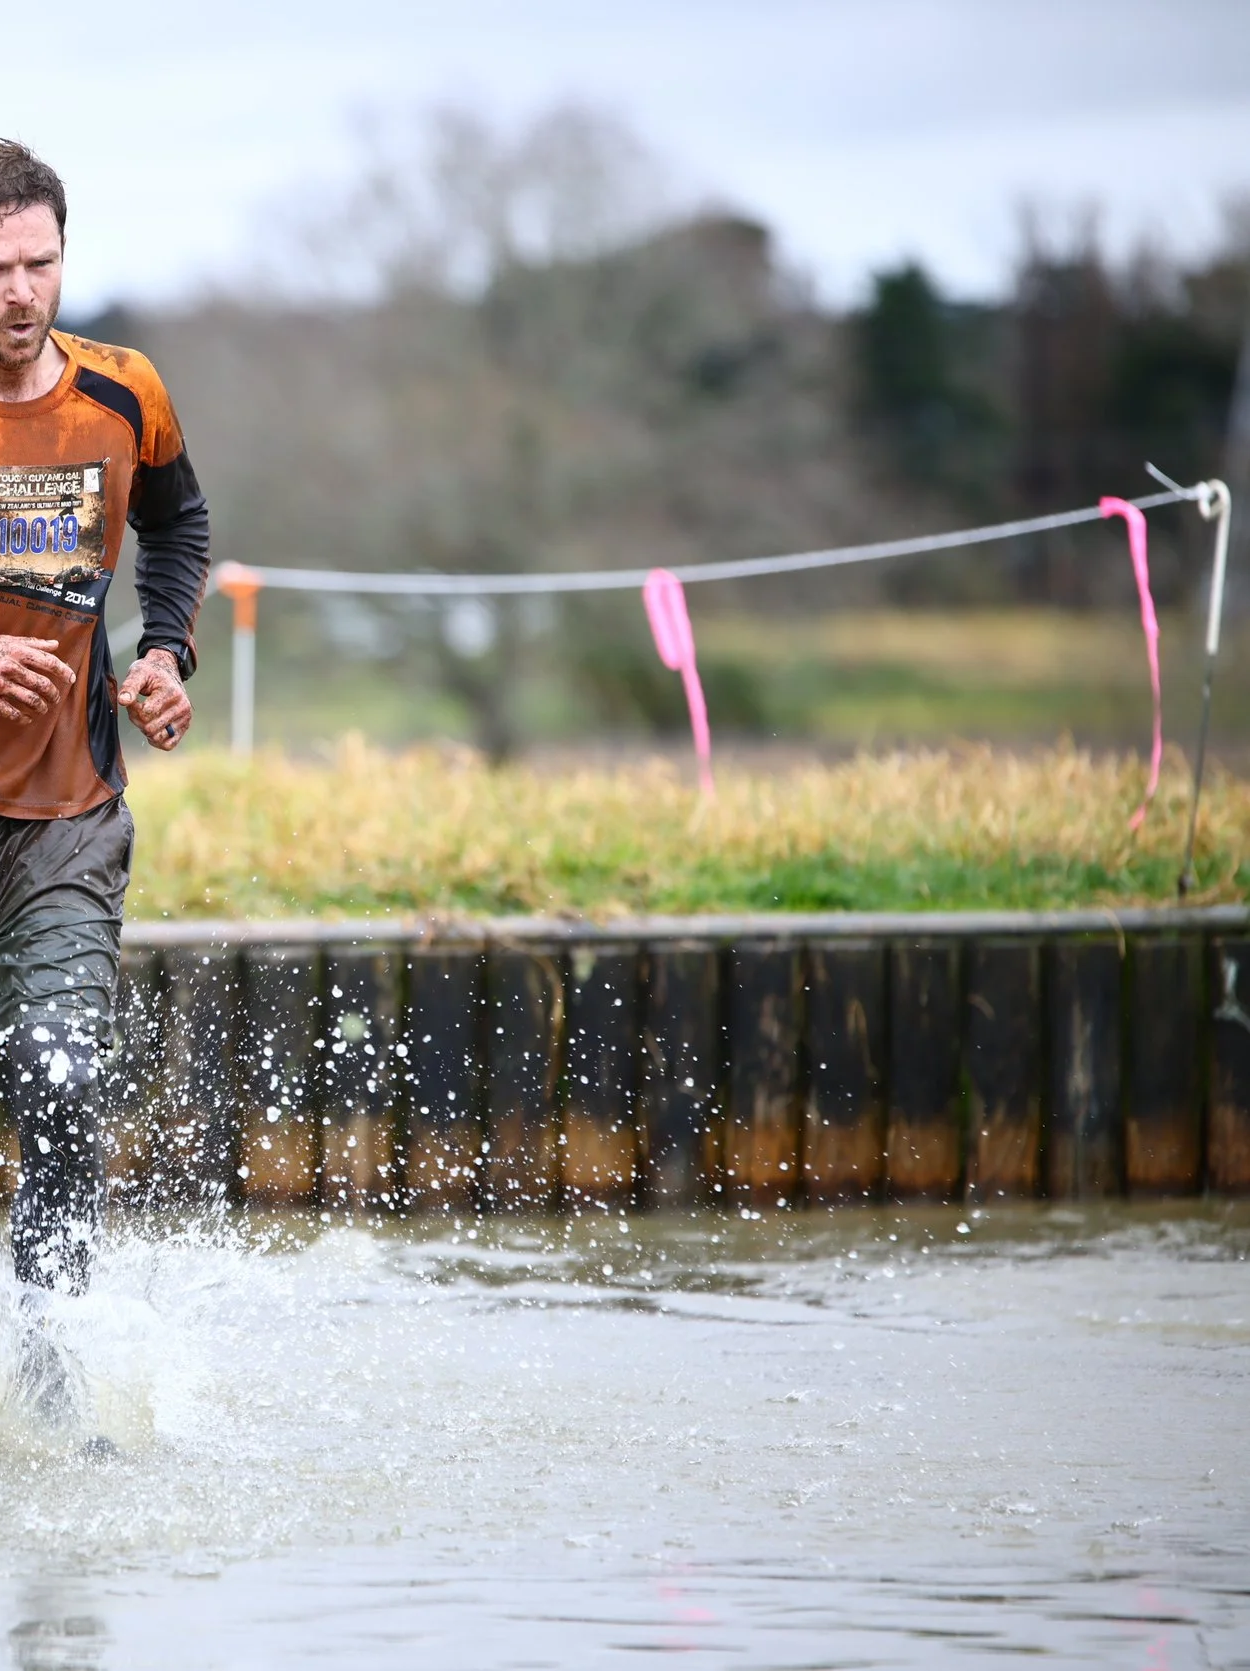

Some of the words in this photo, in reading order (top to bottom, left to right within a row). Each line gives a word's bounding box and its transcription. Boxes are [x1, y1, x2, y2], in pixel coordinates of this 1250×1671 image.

[29, 474, 47, 482] GUY
[47, 473, 64, 481] AND
[65, 472, 81, 480] GAL
[64, 591, 96, 608] 2014
